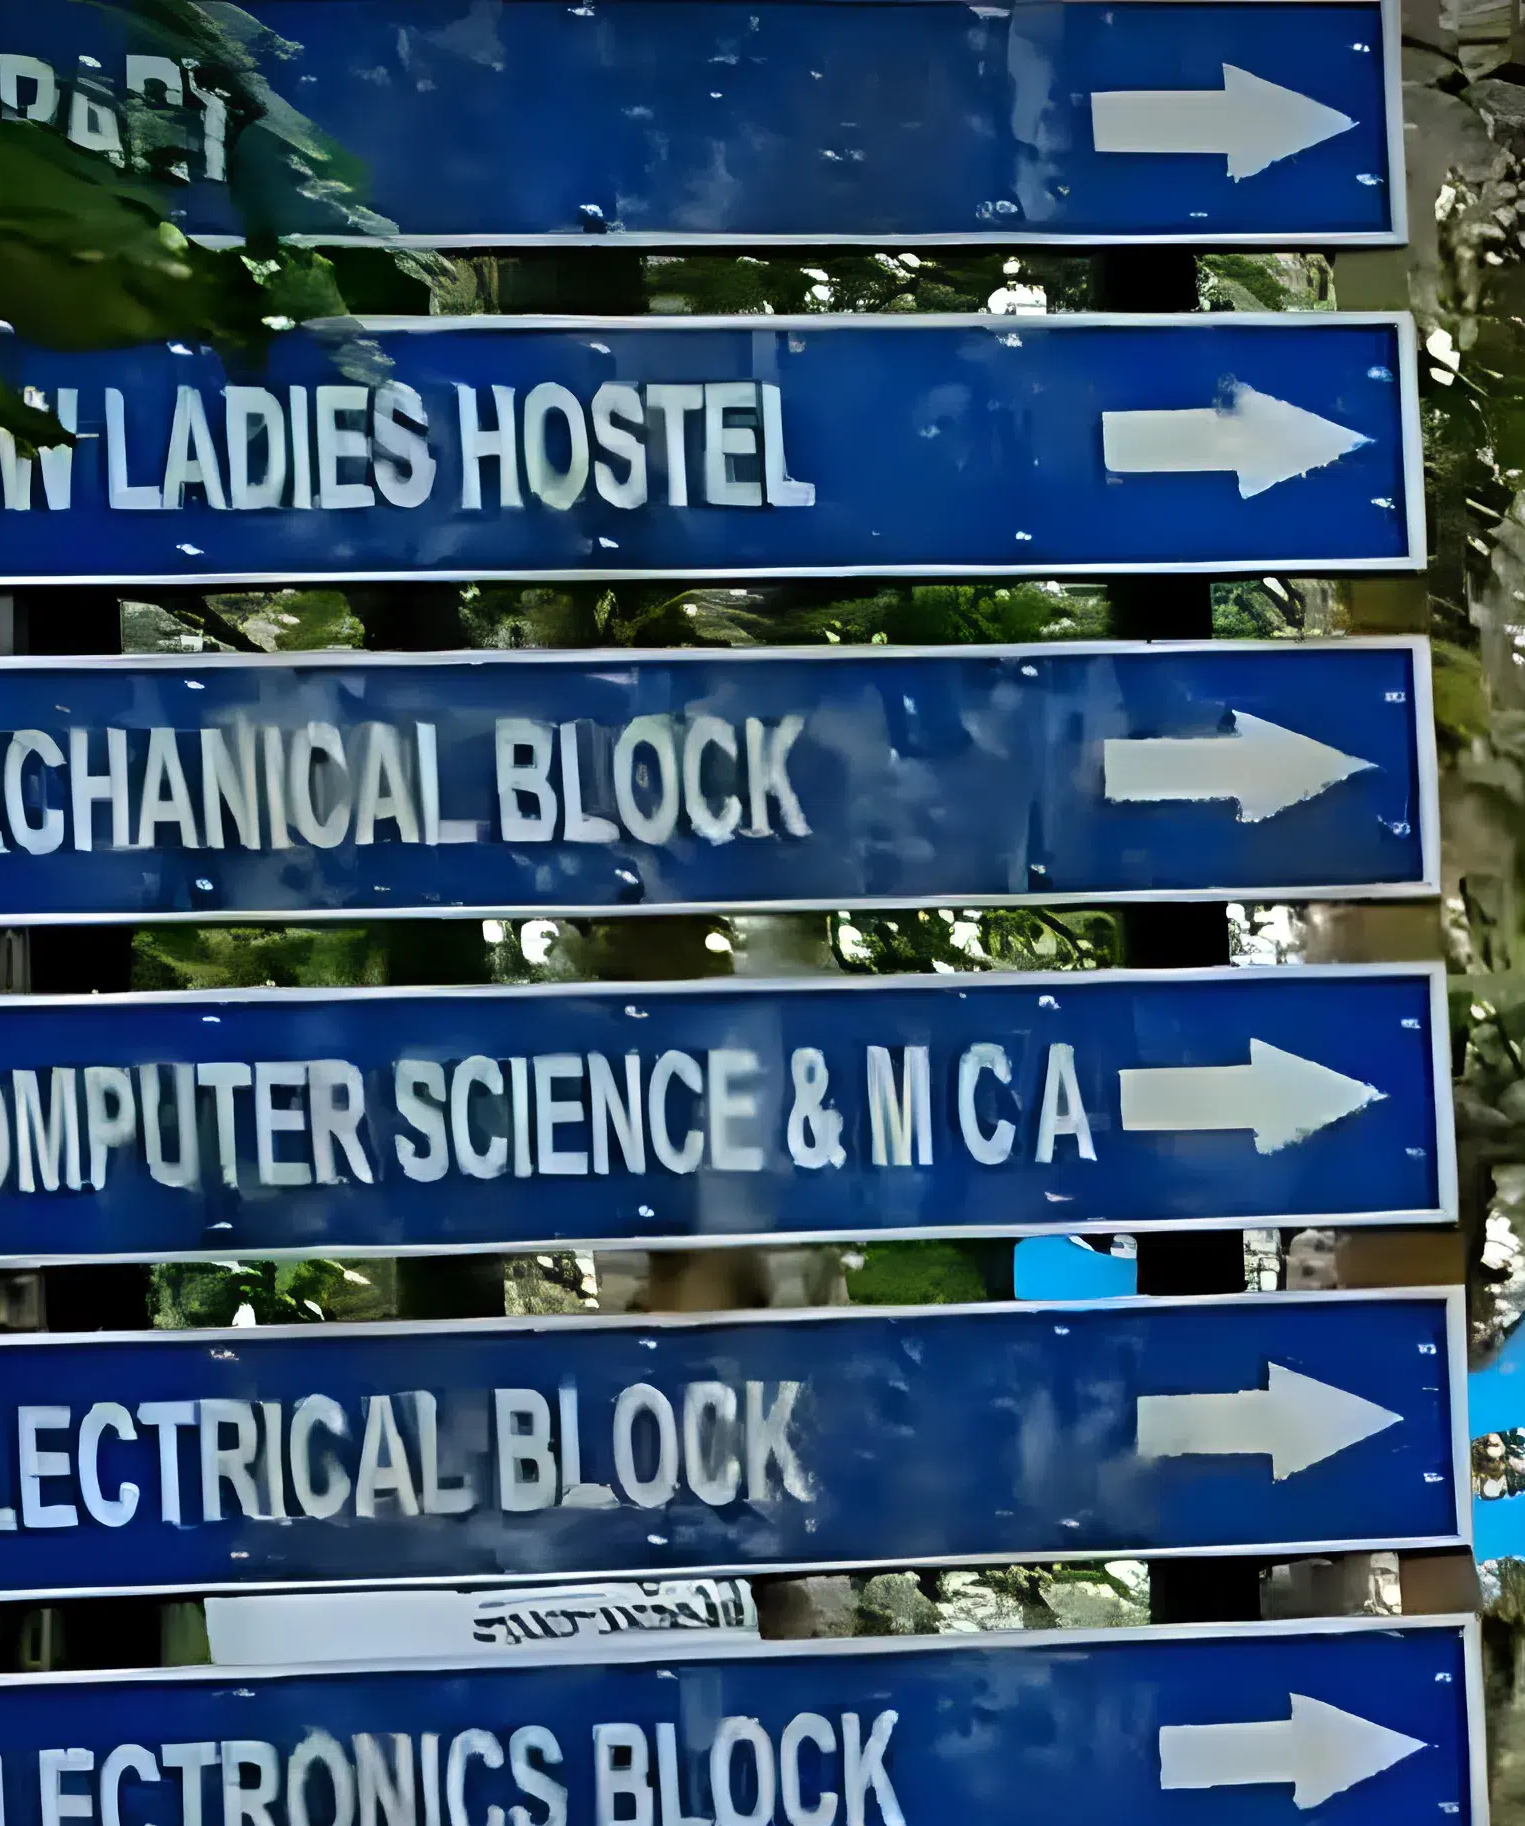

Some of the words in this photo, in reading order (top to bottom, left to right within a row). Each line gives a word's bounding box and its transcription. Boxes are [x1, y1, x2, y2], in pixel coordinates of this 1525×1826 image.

[105, 380, 437, 508] LADIES
[459, 380, 817, 510] HOSTEL
[496, 715, 811, 846] BLOCK
[394, 1048, 762, 1182] SCIENCE
[787, 1048, 847, 1170] &
[869, 1045, 933, 1168] M
[956, 1043, 1016, 1165] C
[1035, 1041, 1097, 1162] A
[494, 1380, 817, 1512] BLOCK
